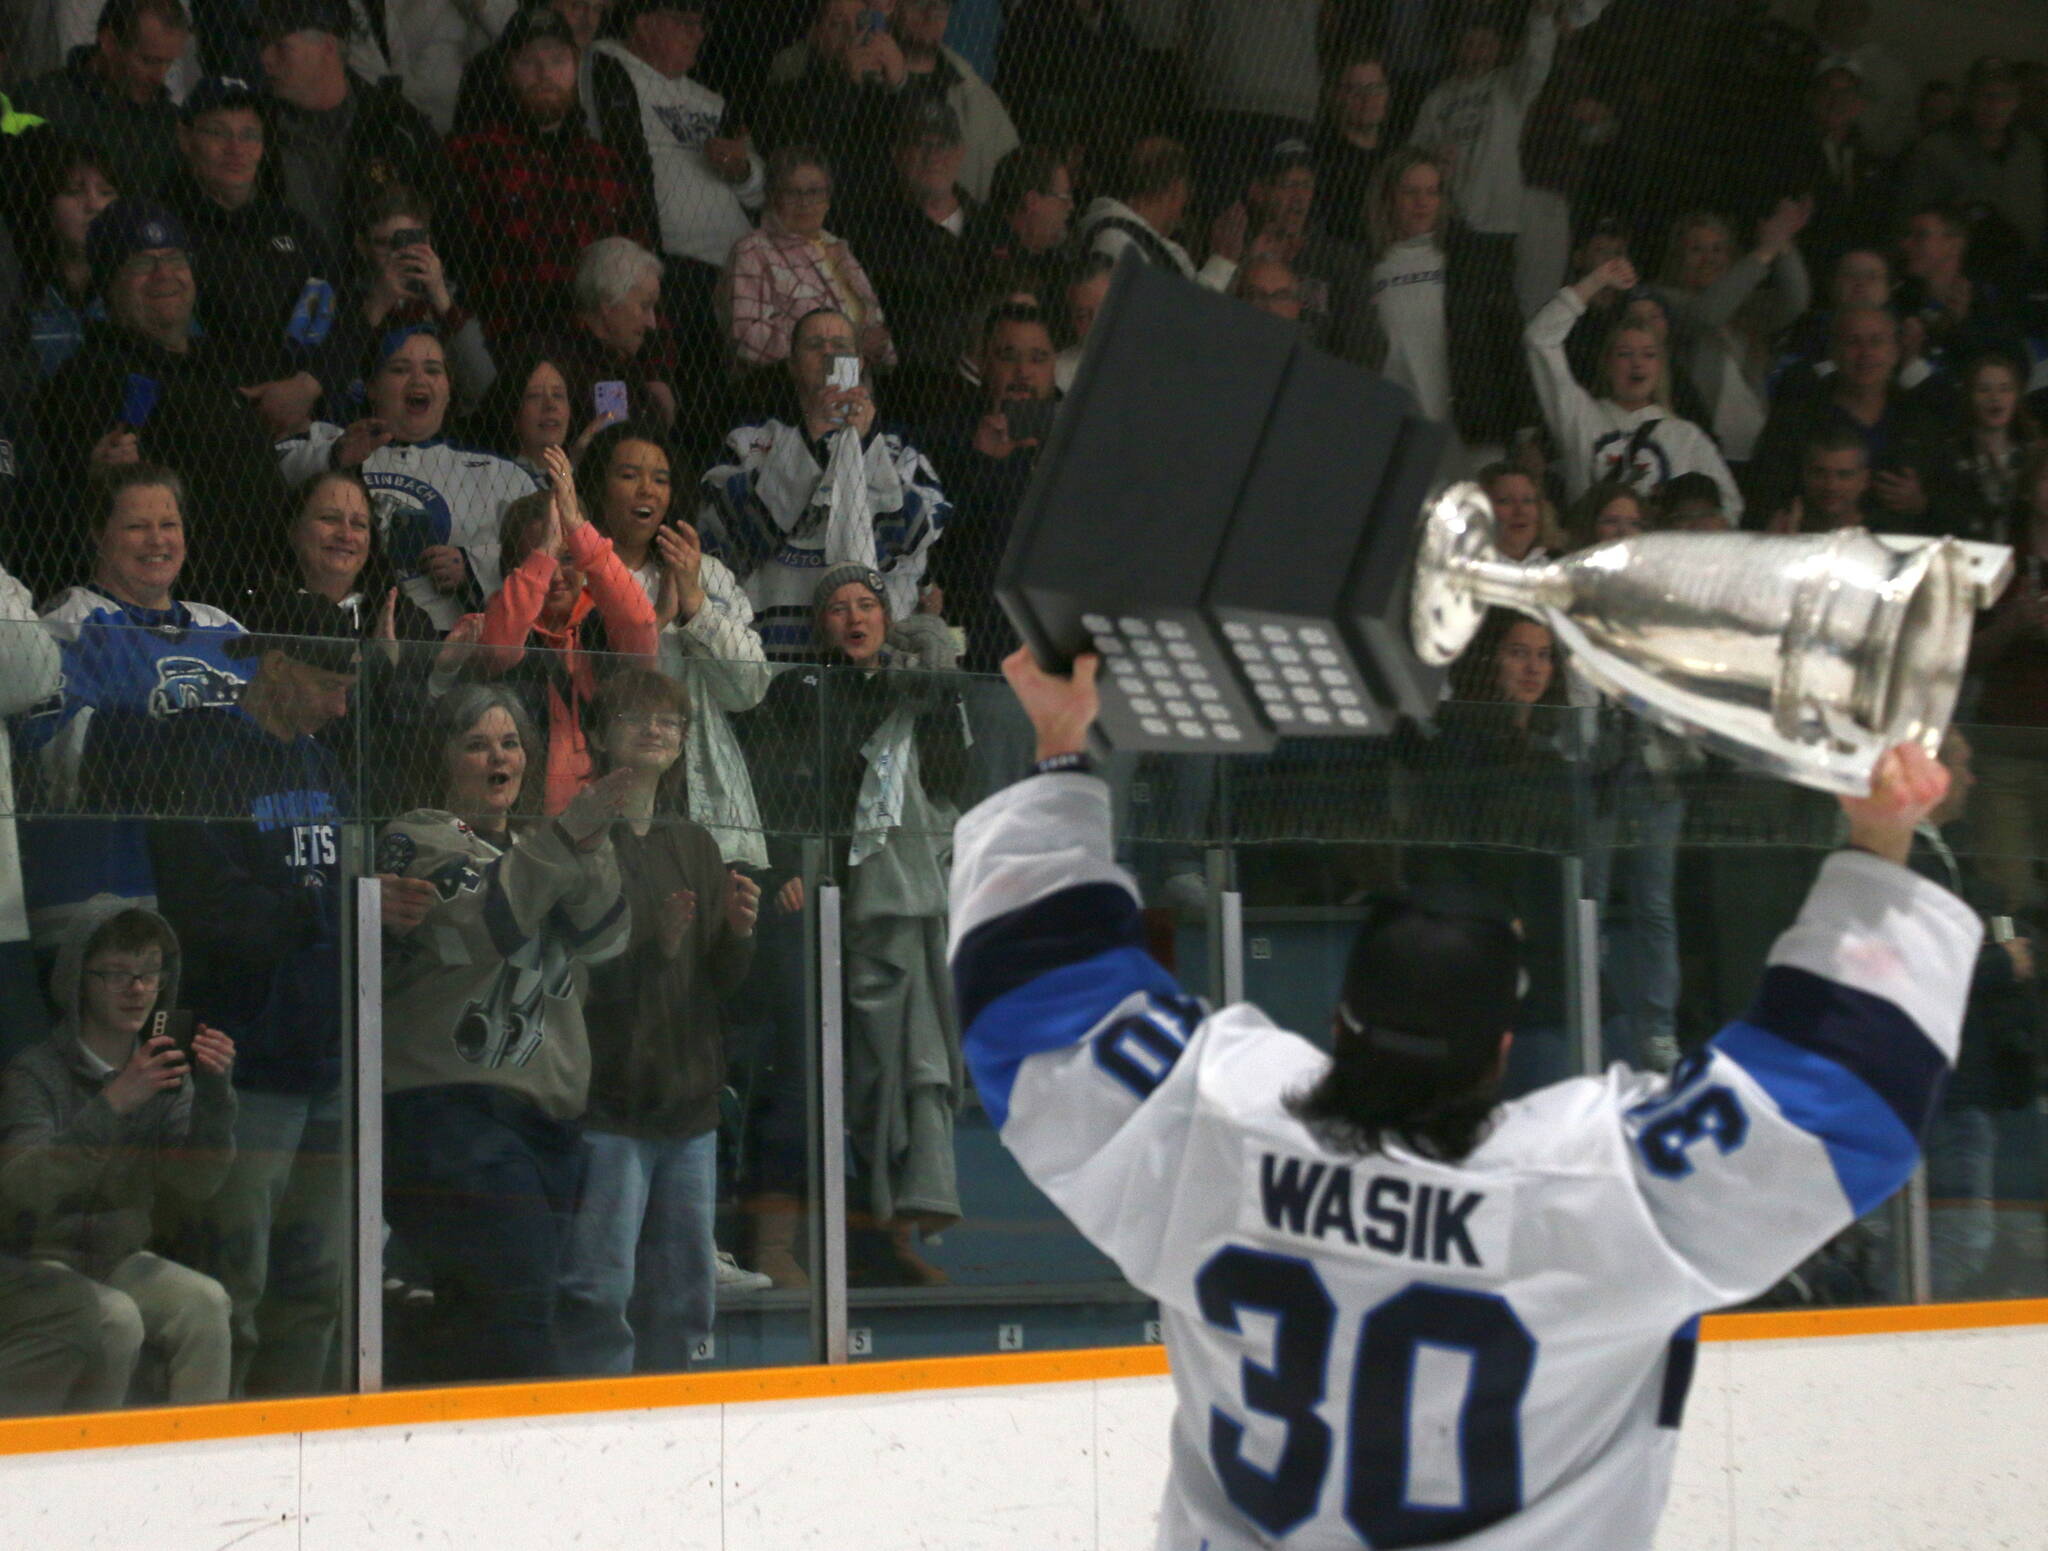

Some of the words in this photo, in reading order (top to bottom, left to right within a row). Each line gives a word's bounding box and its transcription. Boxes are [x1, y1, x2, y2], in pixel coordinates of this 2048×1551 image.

[284, 825, 336, 867] JETS
[1261, 1154, 1485, 1267] WASIK
[854, 1331, 865, 1350] 5
[1006, 1326, 1016, 1347] 4
[1195, 1244, 1539, 1551] 30
